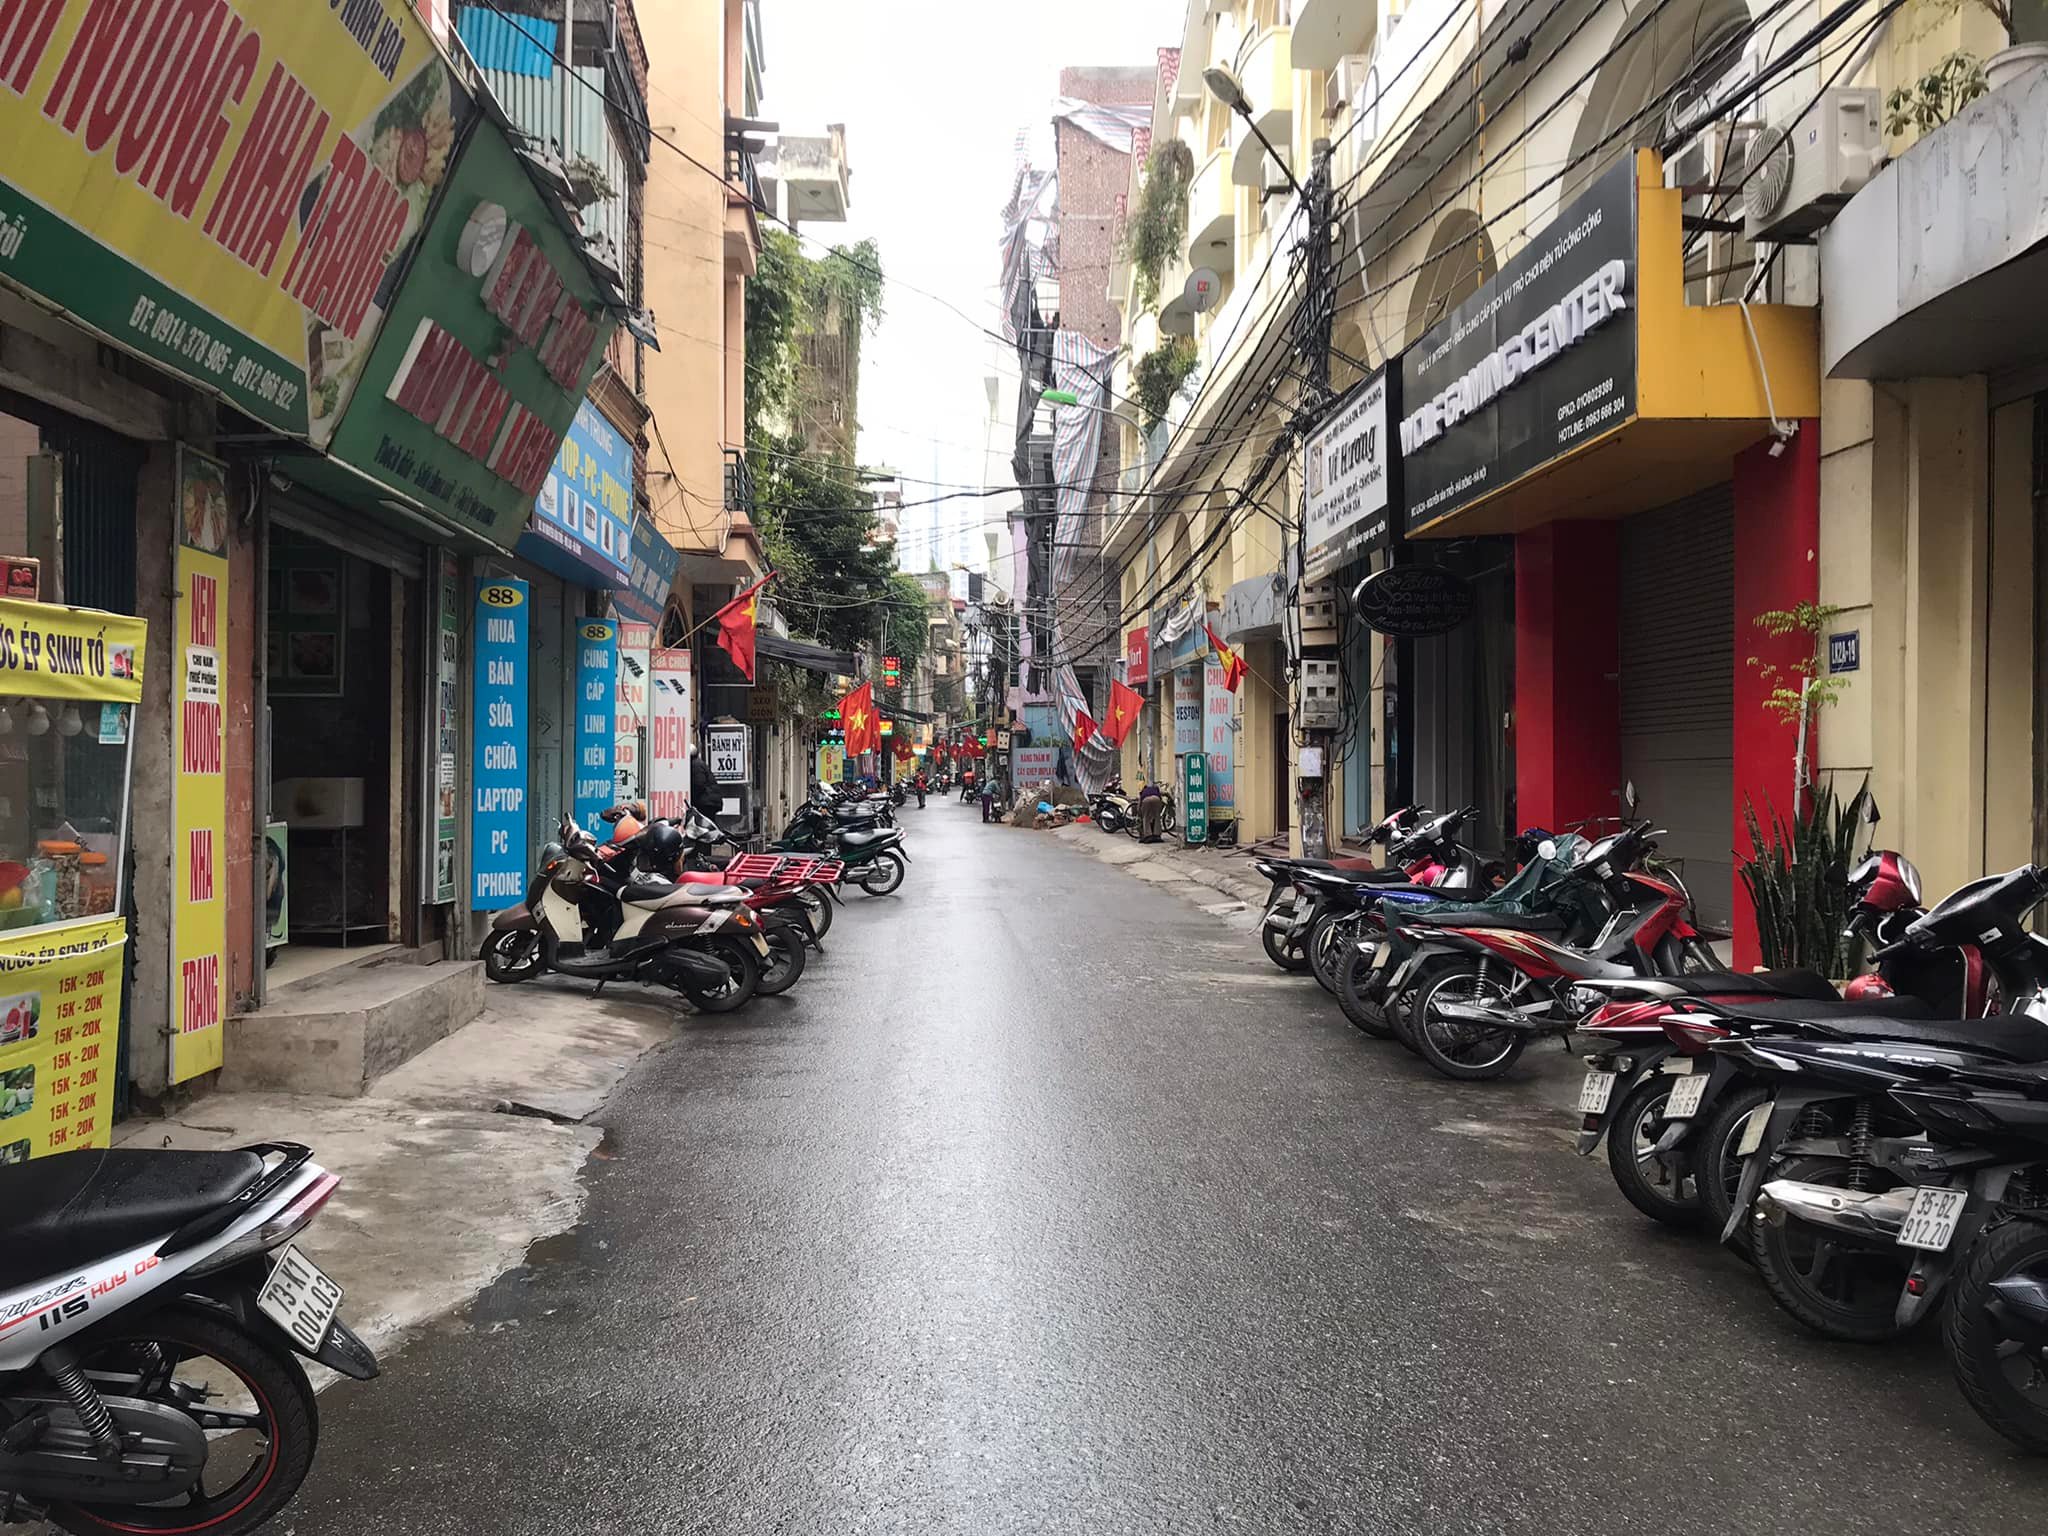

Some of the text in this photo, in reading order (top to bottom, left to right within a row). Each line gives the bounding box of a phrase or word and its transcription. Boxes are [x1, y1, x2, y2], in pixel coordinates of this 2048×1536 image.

[202, 60, 330, 277] NHA
[279, 132, 410, 341] TRANG
[1582, 208, 1602, 238] CỘNG
[151, 309, 187, 350] 0914
[182, 327, 211, 363] 378
[204, 340, 232, 374] 985
[232, 356, 263, 391] 0912
[487, 588, 514, 605] 88
[488, 618, 516, 643] MUA
[586, 626, 606, 639] 88
[20, 621, 41, 671] ÉP
[46, 632, 85, 675] SINH
[87, 625, 106, 678] TỐ
[583, 650, 609, 669] CUNG
[488, 656, 514, 685] BÁN
[586, 675, 605, 701] CẤP
[489, 696, 514, 728] SỬA
[584, 714, 606, 734] LINH
[654, 706, 686, 769] ĐIỆN
[484, 741, 517, 770] CHỮA
[584, 743, 605, 770] KIỆN
[717, 753, 737, 771] XÔI
[477, 788, 523, 812] LAPTOP
[577, 779, 612, 799] LAPTOP
[1188, 791, 1204, 803] XANH
[587, 812, 600, 832] PC
[491, 830, 509, 854] PC
[190, 830, 213, 902] NHA
[477, 872, 522, 897] IPHONE
[59, 976, 77, 994] 15K
[86, 969, 104, 988] 20K
[182, 954, 219, 1034] TRANG
[56, 1001, 76, 1020] 15K
[84, 994, 103, 1013] 20K
[54, 1026, 73, 1045] 15K
[81, 1018, 102, 1037] 20K
[53, 1051, 71, 1071] 15K
[81, 1043, 100, 1062] 20K
[51, 1076, 70, 1097] 15K
[80, 1067, 98, 1087] 20K
[50, 1101, 69, 1122] 15K
[78, 1092, 96, 1112] 20K
[48, 1127, 68, 1147] 15K
[76, 1116, 95, 1137] 20K
[1916, 1191, 1957, 1219] 35-B2
[1902, 1217, 1951, 1248] 912.20
[265, 1256, 312, 1315] 73-K1
[37, 1290, 91, 1332] 115
[90, 1268, 128, 1300] HUY
[289, 1275, 342, 1347] 004.03
